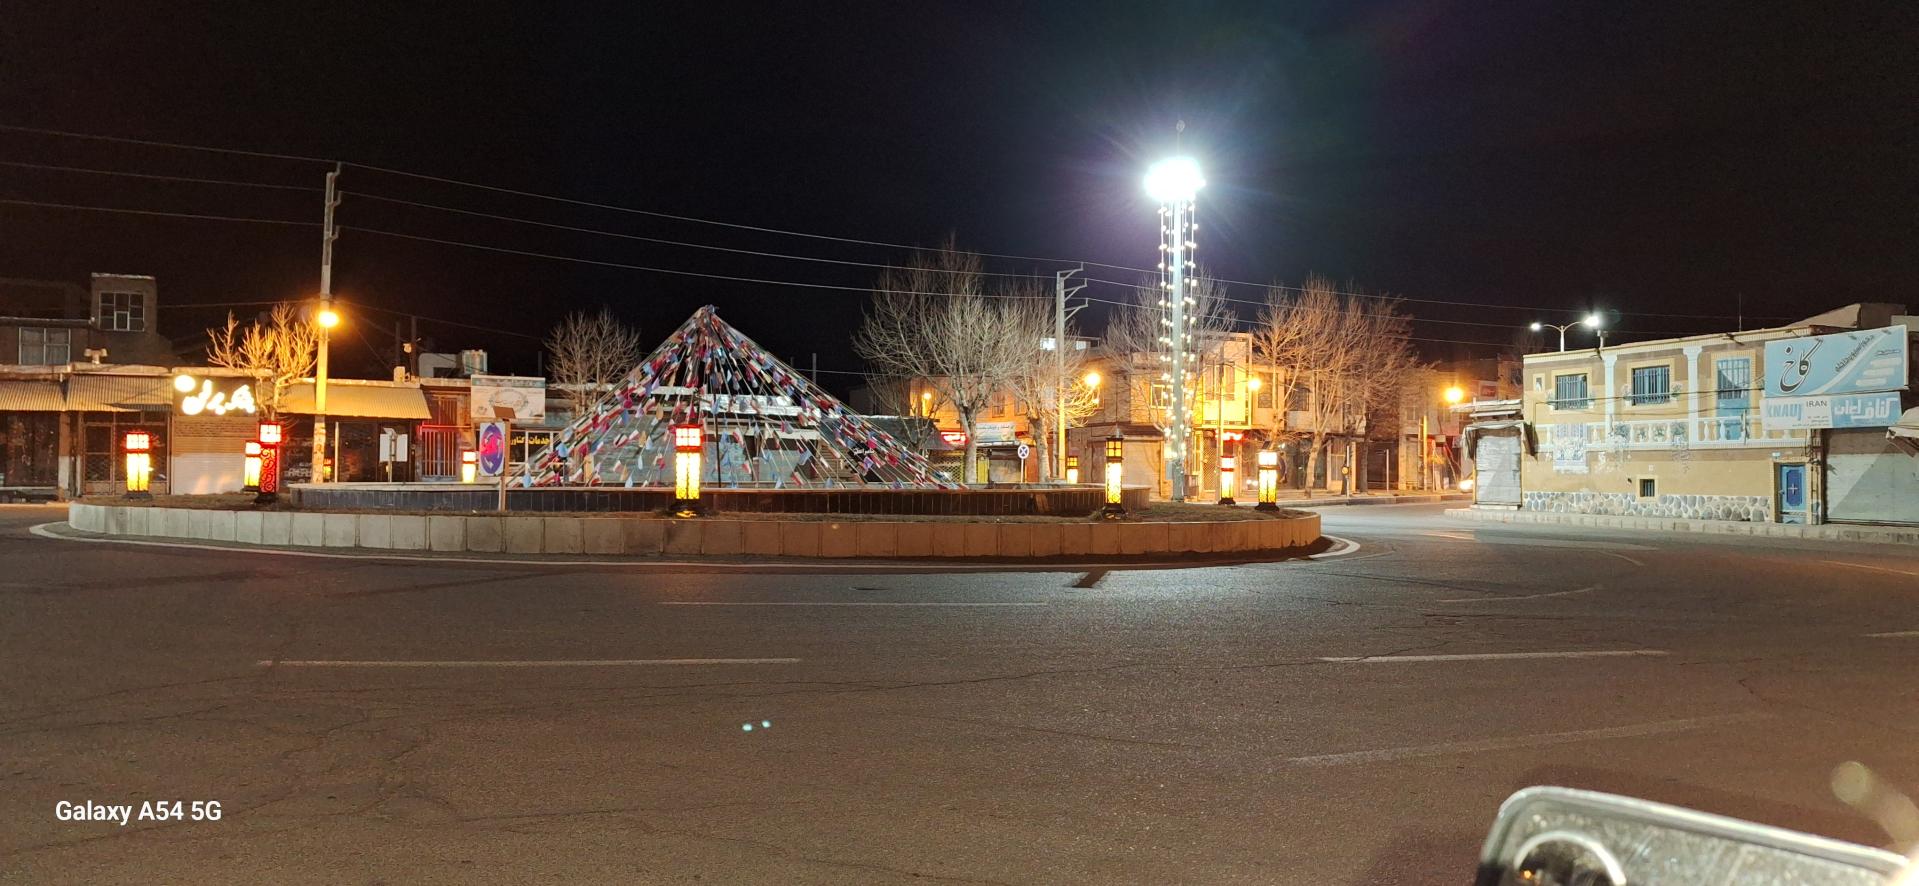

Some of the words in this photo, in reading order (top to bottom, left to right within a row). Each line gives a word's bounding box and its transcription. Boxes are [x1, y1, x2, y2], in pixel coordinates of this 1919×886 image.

[1806, 400, 1828, 408] IRAN
[1851, 397, 1899, 420] کناف
[528, 435, 550, 445] خدمات
